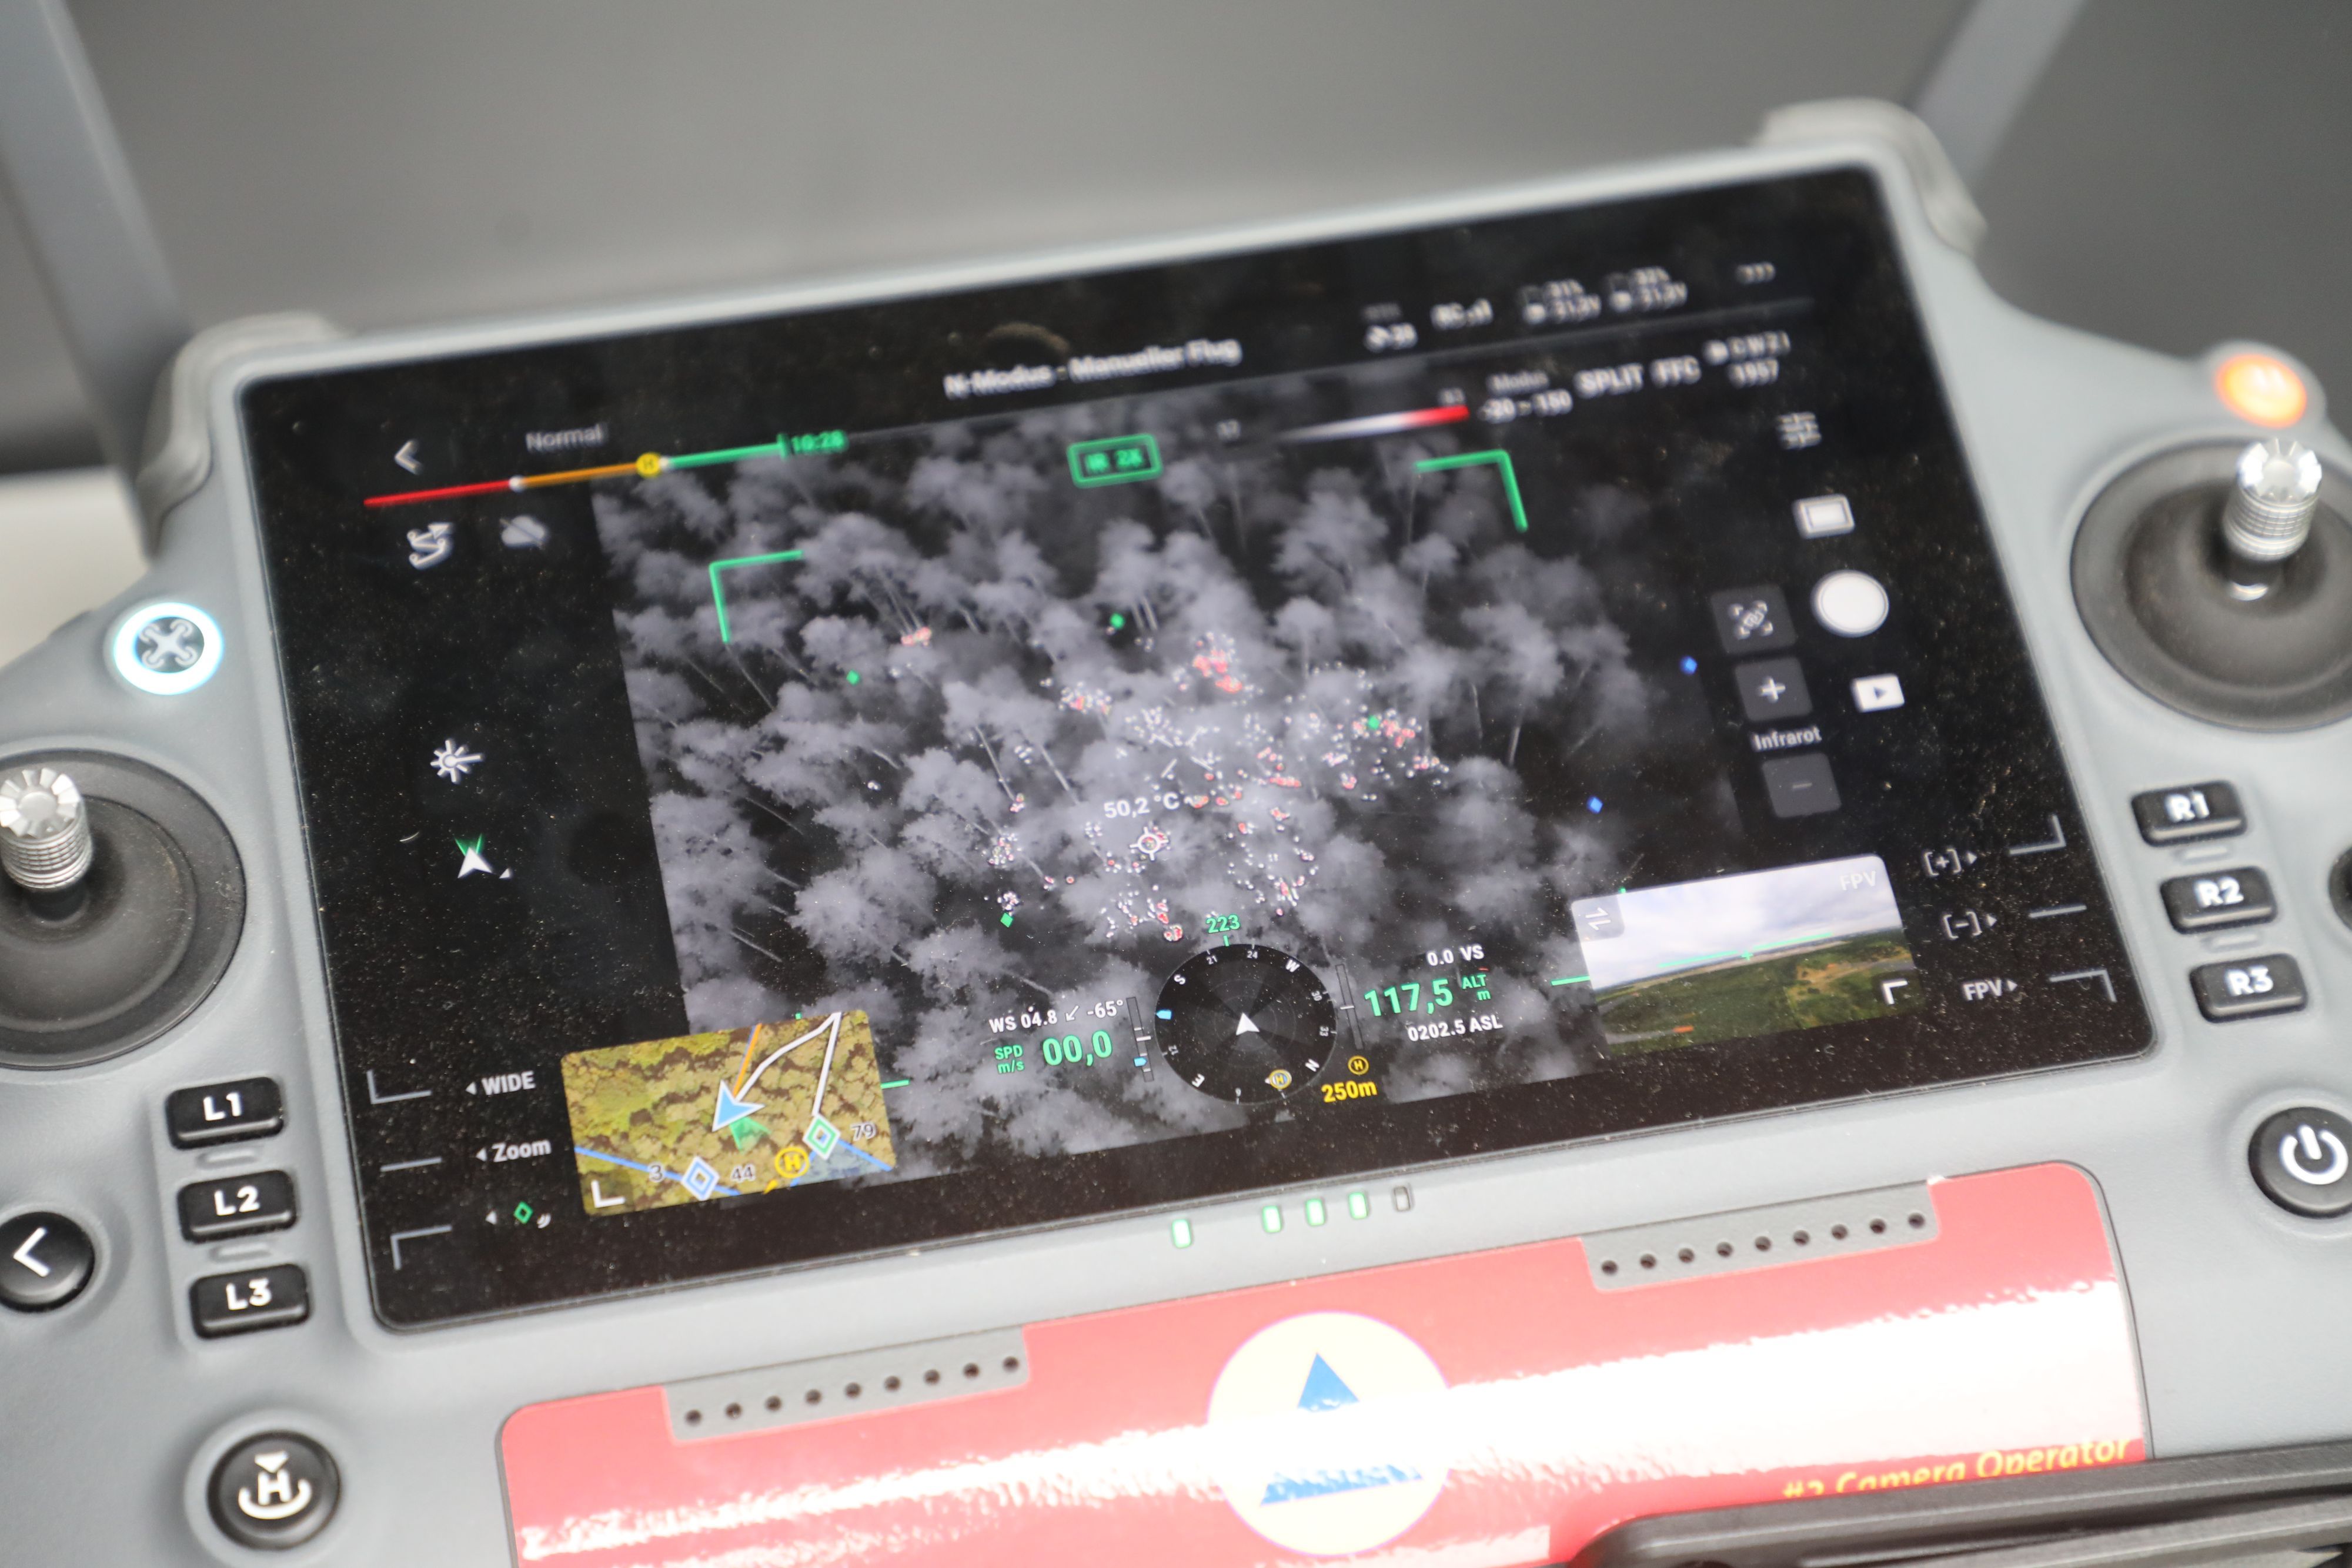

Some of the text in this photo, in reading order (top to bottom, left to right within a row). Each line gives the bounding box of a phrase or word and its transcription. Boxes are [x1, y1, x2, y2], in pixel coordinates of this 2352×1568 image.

[1184, 338, 1242, 367] Flug
[1573, 355, 1702, 399] SPLIT FFC
[525, 422, 608, 453] Normal
[1751, 725, 1822, 752] Infrarot
[1103, 797, 1150, 818] 50,2
[2165, 790, 2210, 823] R1
[1840, 870, 1877, 891] FPV
[2194, 876, 2244, 908] R2
[1205, 914, 1241, 934] 223
[1206, 954, 1218, 965] 21
[1247, 950, 1258, 959] 24
[1285, 958, 1301, 973] W
[1426, 944, 1485, 967] 0.0 VS
[1173, 974, 1186, 985] S
[1962, 977, 2002, 1001] FPV
[2224, 965, 2274, 996] R3
[1310, 989, 1323, 1002] 30
[1364, 974, 1487, 1017] 117,5 ALT
[1476, 989, 1492, 1001] m
[988, 999, 1124, 1034] WS 04.8 -65°
[1407, 1014, 1504, 1042] 0202.5 ASL
[1318, 1025, 1330, 1037] 33
[994, 1044, 1024, 1061] SPD
[1042, 1029, 1114, 1067] 00,0
[997, 1059, 1025, 1075] m/s
[1304, 1058, 1320, 1072] N
[481, 1070, 536, 1096] WIDE
[1191, 1072, 1205, 1088] E
[1321, 1080, 1378, 1104] 250m
[202, 1092, 242, 1121] L1
[851, 1122, 876, 1140] 79
[491, 1139, 552, 1163] Zoom
[650, 1164, 664, 1182] 3
[731, 1165, 755, 1182] 44
[213, 1185, 261, 1216] L2
[225, 1278, 272, 1310] L3
